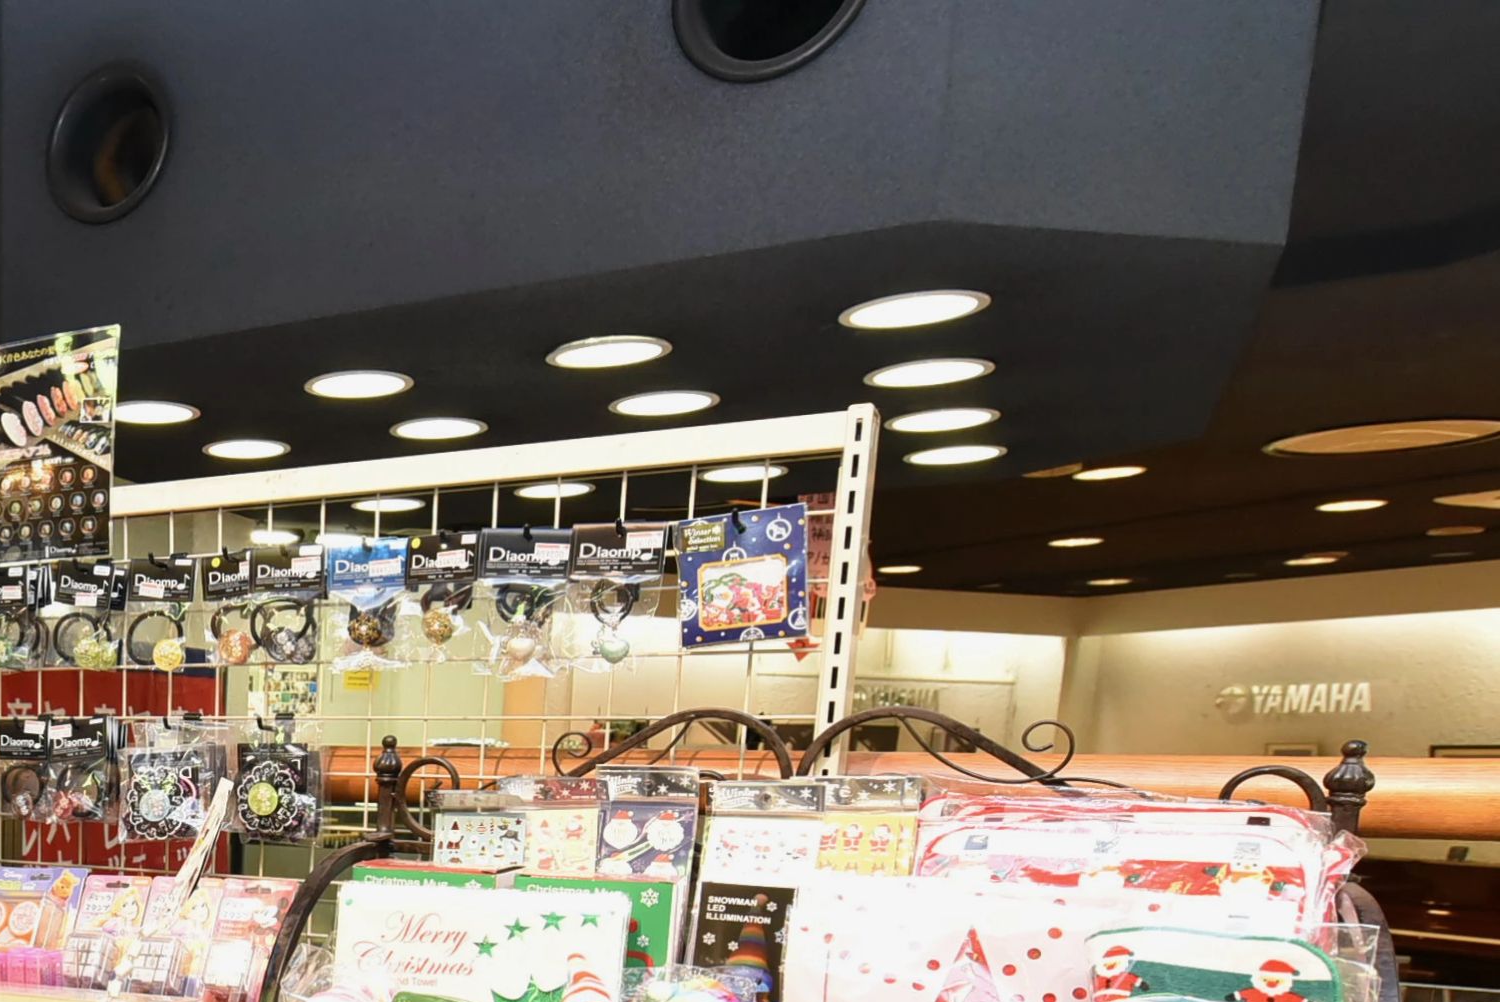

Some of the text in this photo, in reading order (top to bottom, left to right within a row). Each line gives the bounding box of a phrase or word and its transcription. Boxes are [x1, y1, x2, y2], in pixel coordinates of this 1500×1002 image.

[579, 543, 641, 560] Diaomp
[335, 559, 369, 574] Diao
[60, 575, 98, 593] Diaomp
[1250, 682, 1372, 714] YAMAHA
[0, 734, 34, 748] Diaomp
[53, 735, 92, 750] Diaomp
[706, 904, 726, 913] LED
[707, 895, 758, 908] SNOWMAN
[705, 912, 772, 925] ILLUMINATION
[380, 910, 469, 956] Merry
[411, 977, 438, 987] Towel
